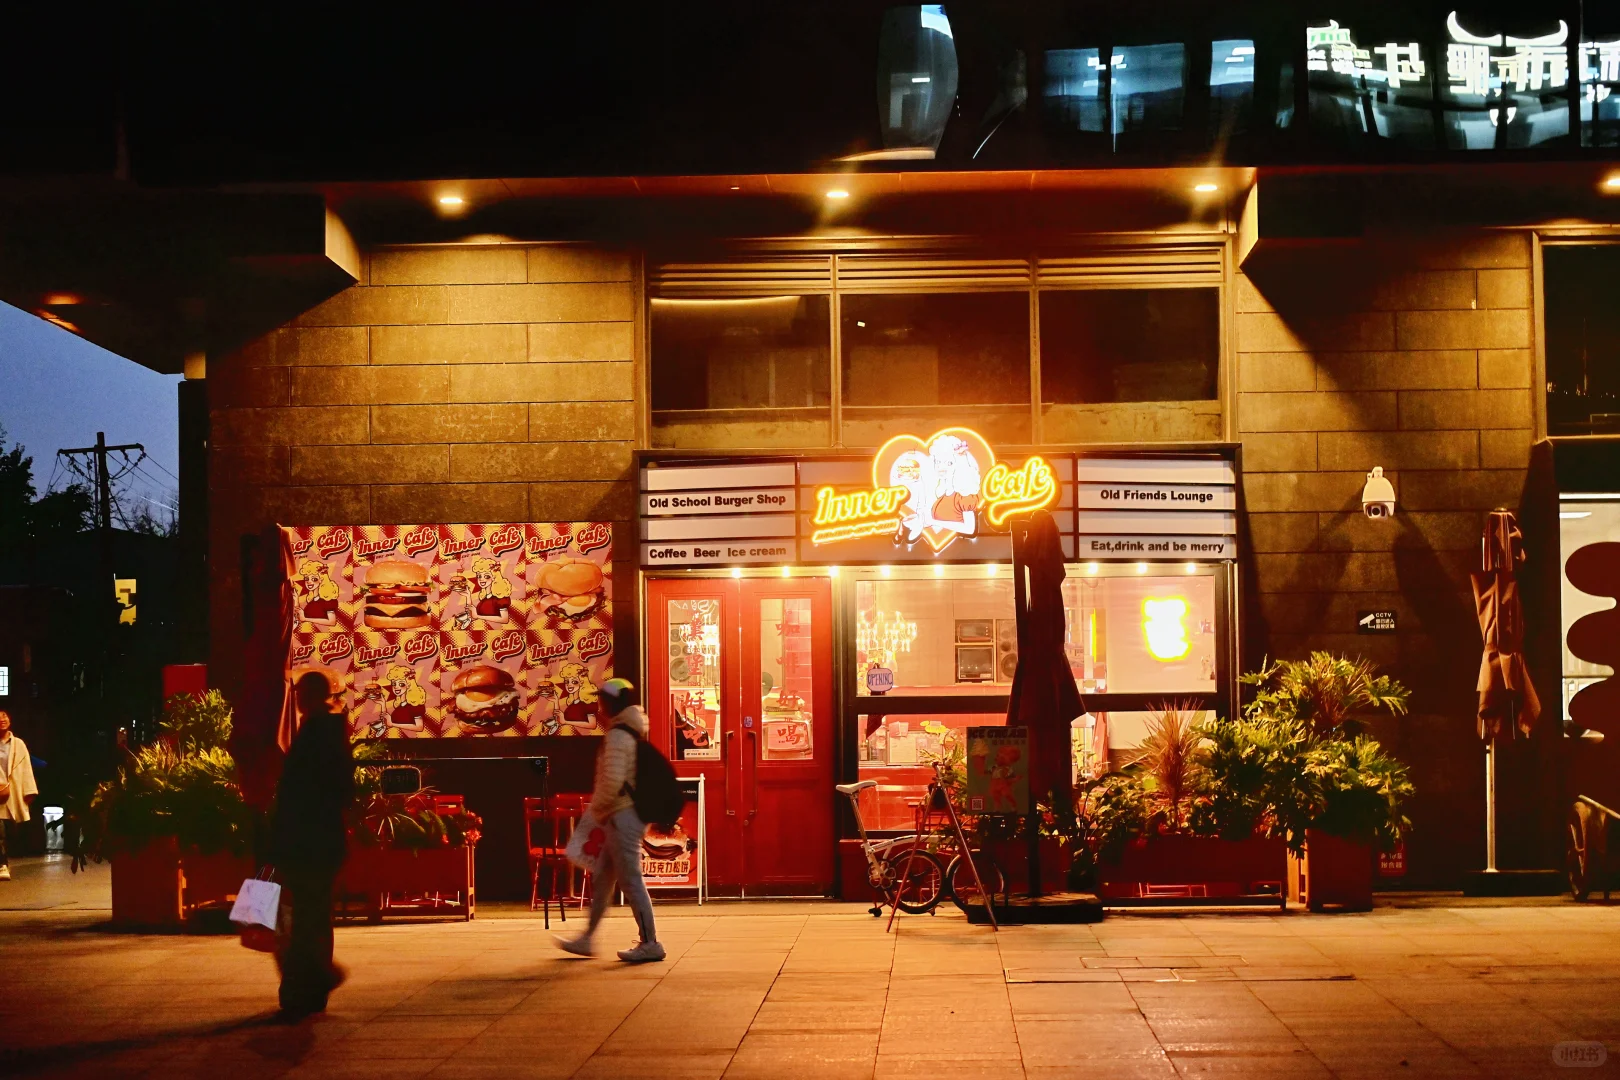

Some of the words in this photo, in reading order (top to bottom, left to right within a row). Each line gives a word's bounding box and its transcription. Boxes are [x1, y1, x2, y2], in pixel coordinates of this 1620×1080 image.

[649, 498, 669, 509] Old
[672, 496, 711, 508] School
[714, 495, 753, 508] Burger
[756, 493, 786, 506] Shop
[812, 486, 909, 526] Inner
[982, 457, 1055, 524] Cafe
[1100, 489, 1120, 500] Old
[1124, 489, 1167, 500] Friends
[1170, 490, 1213, 503] Lounge
[316, 527, 351, 559] Cafe
[357, 537, 400, 558] Inner
[403, 526, 439, 558] Cafe
[443, 536, 485, 557] Inner
[489, 526, 525, 557] Cafe
[529, 533, 573, 555] Inner
[576, 524, 611, 556] Cafe
[649, 547, 687, 559] Coffee
[693, 547, 721, 558] Beer
[727, 547, 746, 557] Ice
[749, 547, 786, 556] cream
[1091, 540, 1144, 553] Eat,drink
[1147, 541, 1169, 551] and
[1173, 541, 1187, 551] be
[1190, 543, 1224, 554] merry
[318, 633, 353, 663] Cafe
[358, 642, 401, 664] Inner
[404, 633, 440, 664] Cafe
[444, 640, 487, 663] Inner
[490, 631, 526, 662] Cafe
[530, 640, 574, 663] Inner
[577, 631, 612, 662] Cafe
